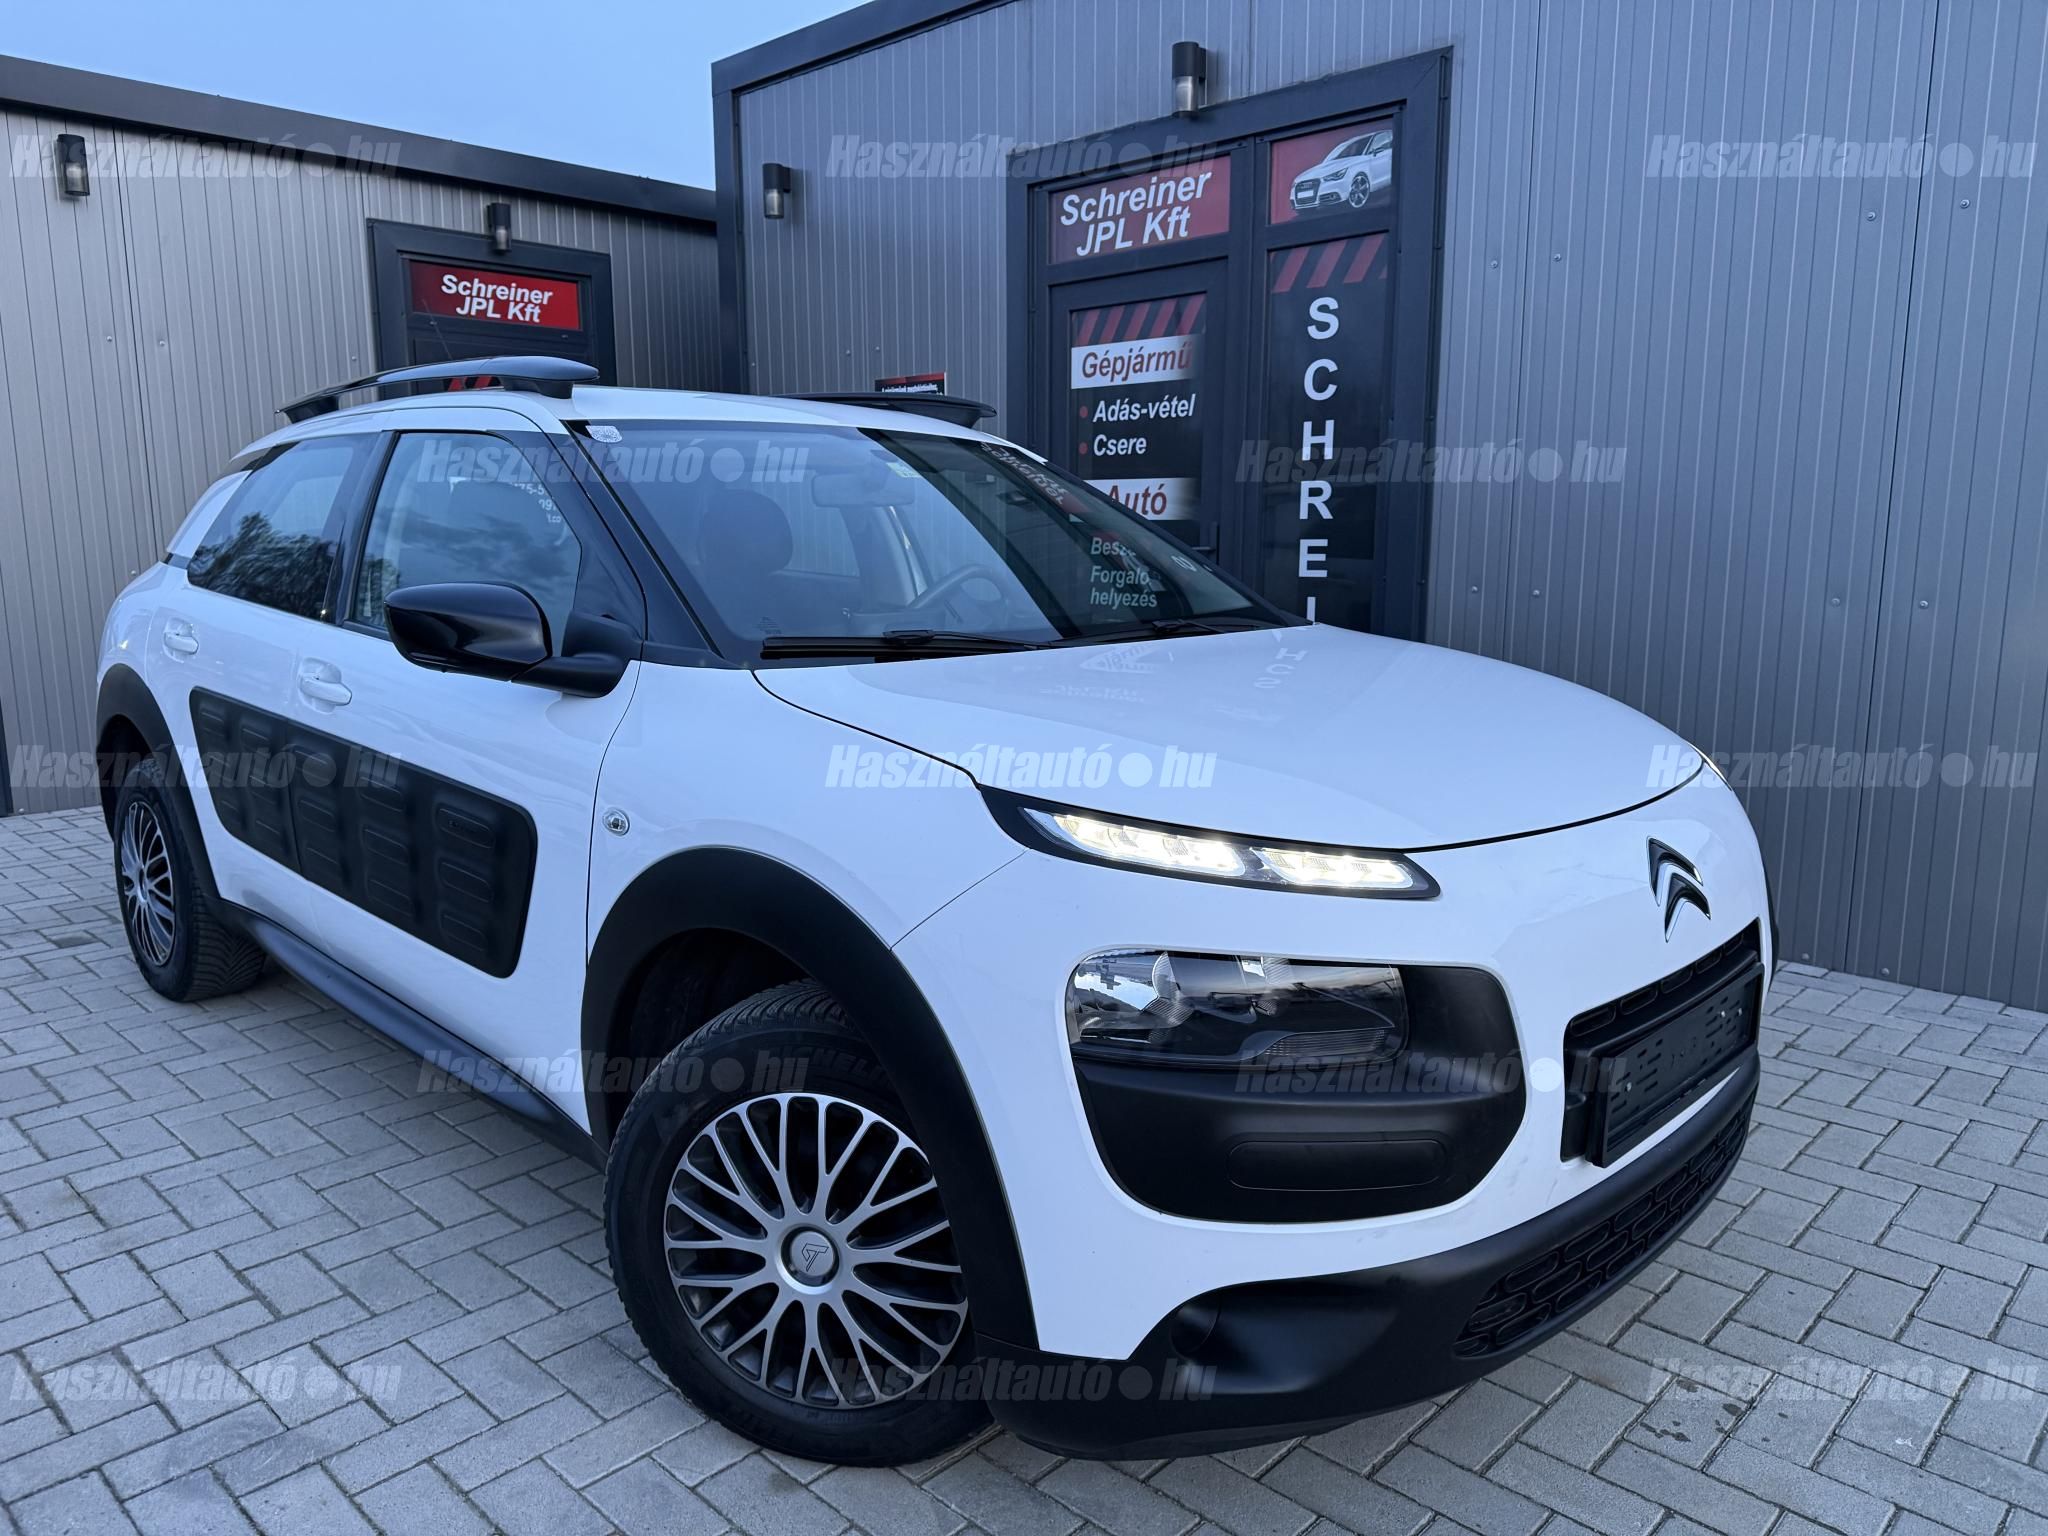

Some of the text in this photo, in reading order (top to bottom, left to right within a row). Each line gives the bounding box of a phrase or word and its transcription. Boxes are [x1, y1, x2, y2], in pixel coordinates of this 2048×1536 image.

[1060, 171, 1212, 226] Schreiner
[1076, 205, 1191, 256] JPL Kft
[441, 274, 553, 305] Schreiner
[456, 297, 542, 322] JPL Kft
[1082, 341, 1193, 383] Gépjármű
[1092, 393, 1197, 423] Adás-vétel
[1093, 433, 1148, 457] Csere
[1090, 565, 1152, 588] Forgalo
[1090, 586, 1159, 611] helyezés
